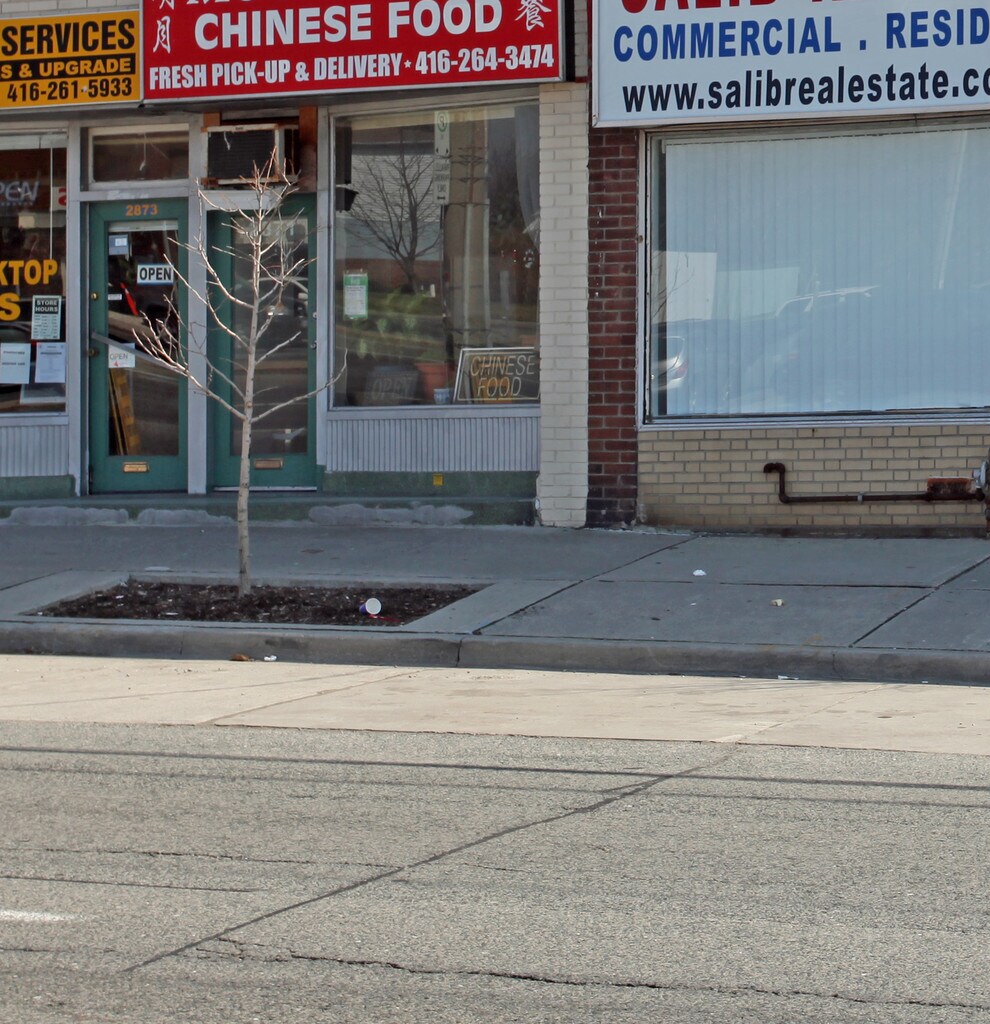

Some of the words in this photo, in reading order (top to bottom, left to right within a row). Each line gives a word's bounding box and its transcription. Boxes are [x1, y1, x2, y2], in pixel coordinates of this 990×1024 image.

[1, 18, 135, 56] SERVICES
[195, 3, 372, 50] CHINESE
[613, 16, 841, 63] COMMERCIAL
[19, 63, 32, 78] &
[39, 57, 131, 77] UPGRADE
[150, 64, 207, 90] FRESH
[212, 59, 291, 86] PICK-UP
[295, 61, 310, 82] &
[314, 52, 402, 81] DELIVERY
[415, 43, 554, 74] 416-264-3474
[125, 204, 158, 216] 2873
[139, 266, 172, 281] OPEN
[470, 355, 536, 376] CHINESE
[477, 376, 522, 397] FOOD
